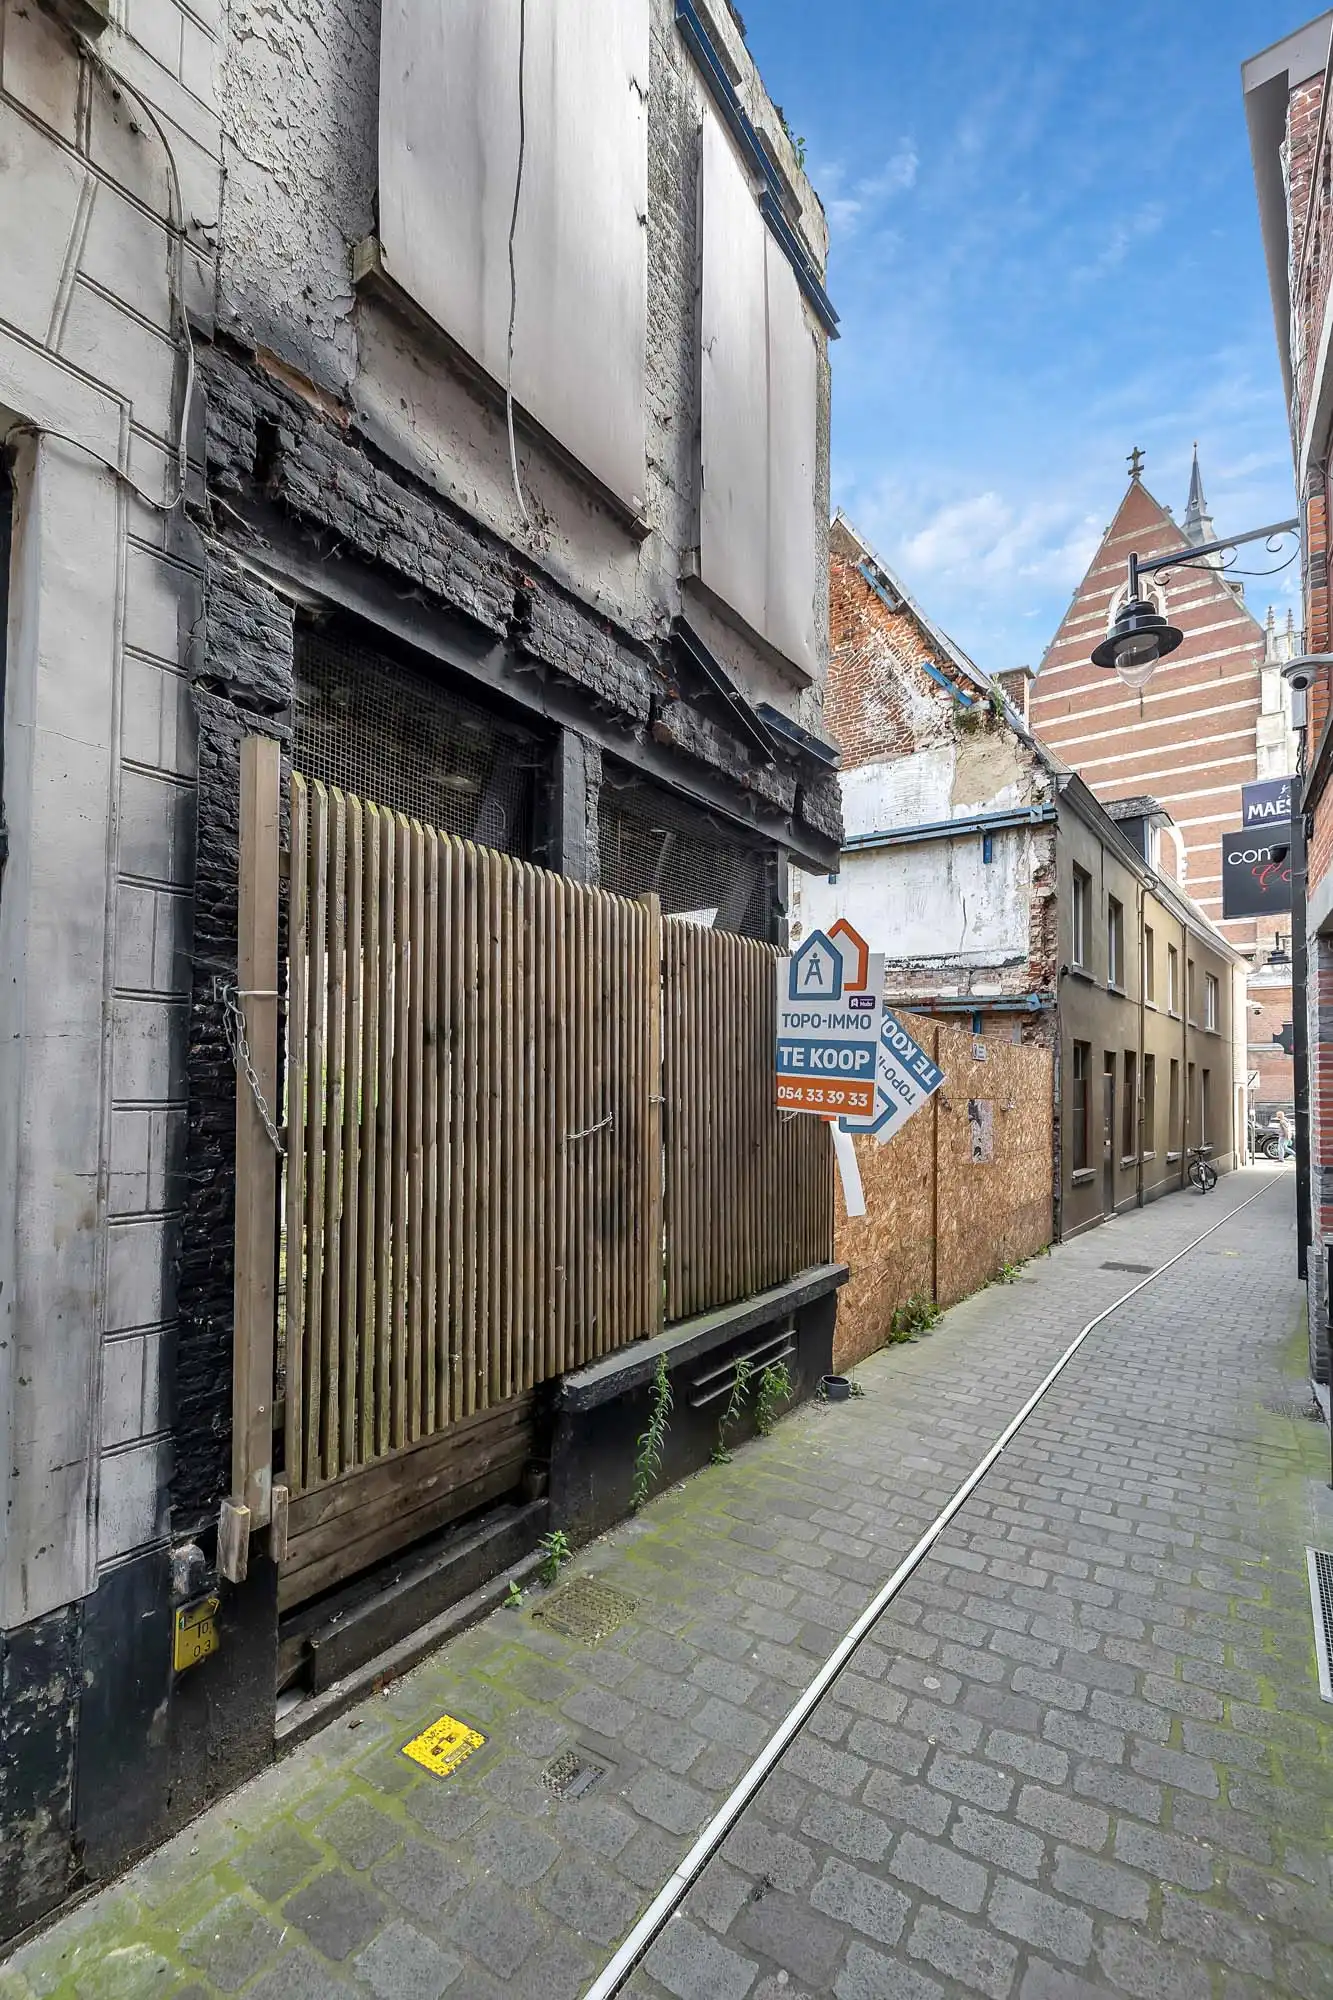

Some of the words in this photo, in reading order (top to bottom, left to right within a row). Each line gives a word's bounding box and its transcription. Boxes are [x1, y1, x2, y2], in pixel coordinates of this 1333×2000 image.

[781, 1013, 872, 1030] TOPO-IMMO
[779, 1046, 805, 1067] TE
[809, 1047, 871, 1071] KOOP
[912, 1055, 937, 1086] TE
[777, 1085, 804, 1100] 054
[806, 1088, 824, 1103] 33
[826, 1090, 845, 1105] 39
[847, 1092, 868, 1107] 33
